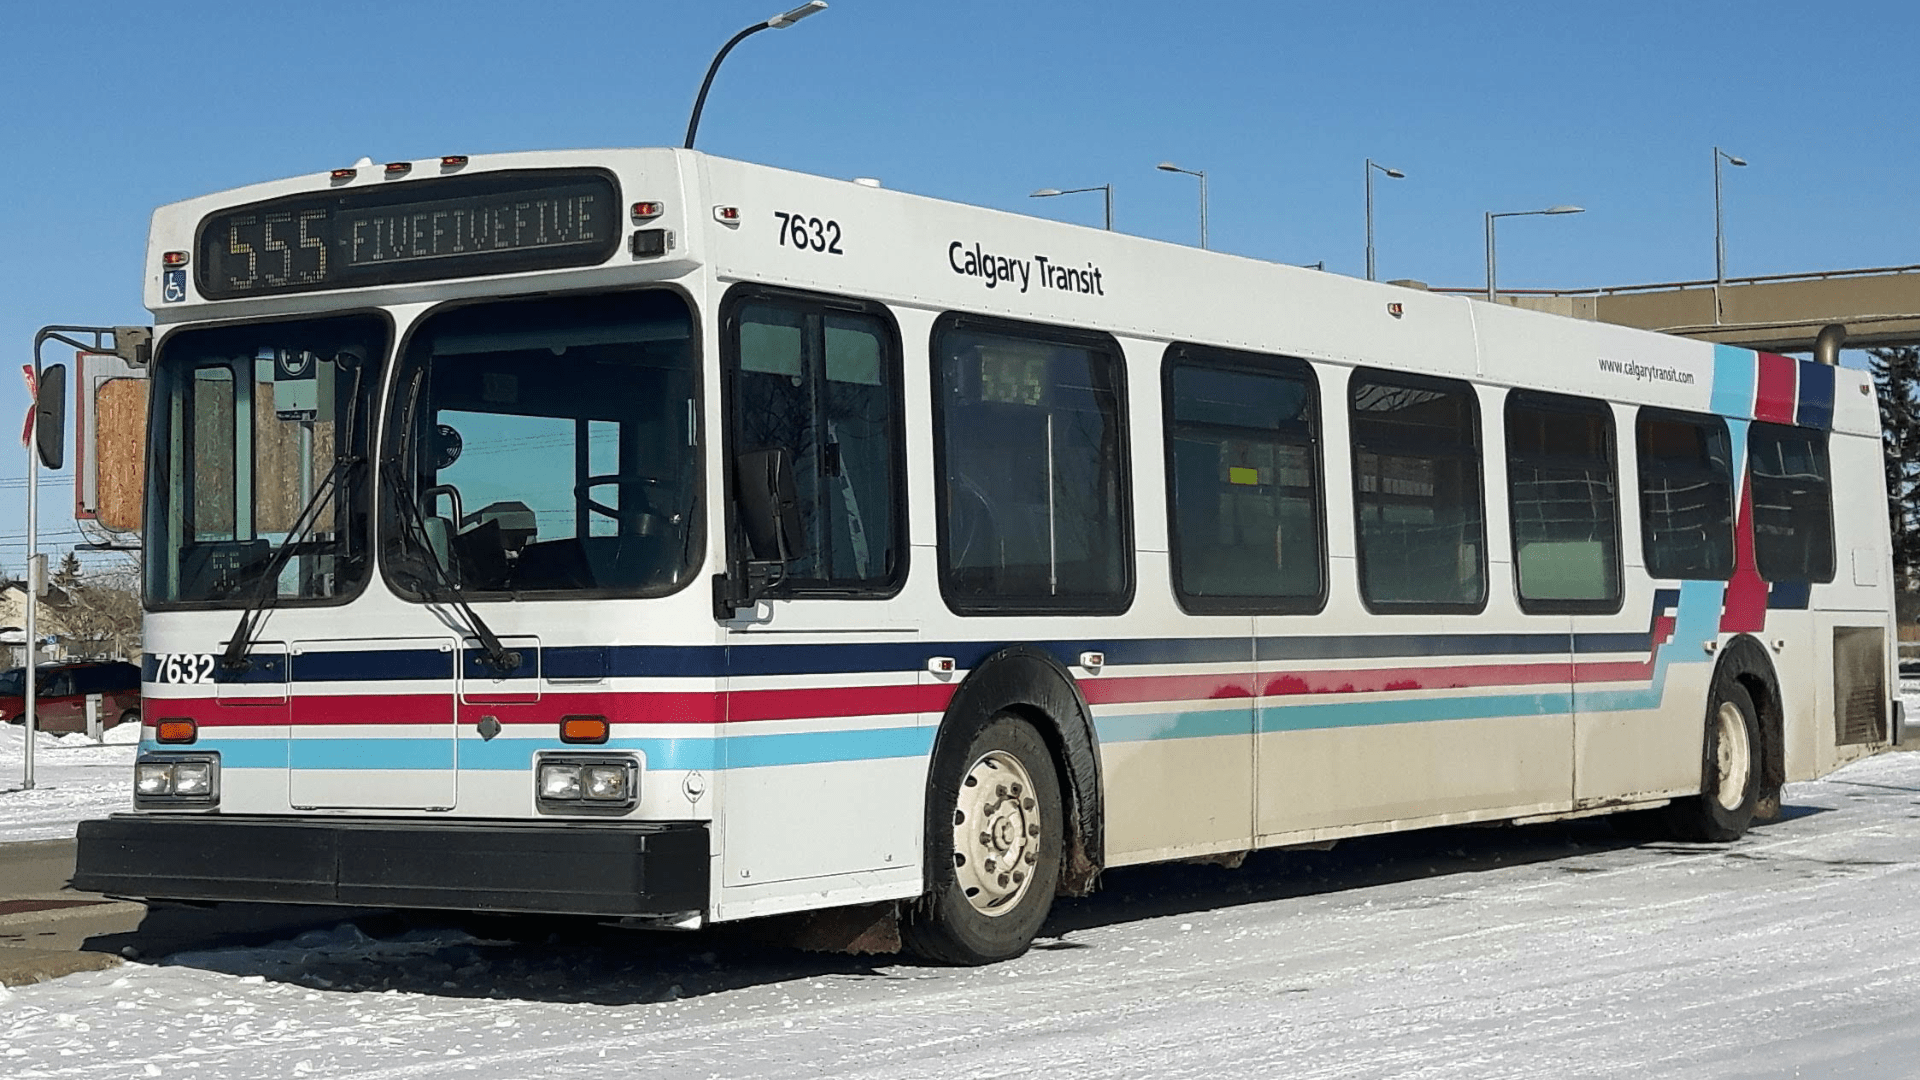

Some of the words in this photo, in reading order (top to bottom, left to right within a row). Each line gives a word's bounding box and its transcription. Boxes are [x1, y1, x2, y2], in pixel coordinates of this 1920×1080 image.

[230, 208, 328, 290] 555
[353, 195, 594, 262] FIVEFIVEFIVE
[774, 210, 843, 255] 7632
[948, 241, 1030, 293] Calgary
[1035, 255, 1104, 296] Transit
[1598, 359, 1695, 384] www.calgarytransit.com
[155, 653, 215, 684] 7632
